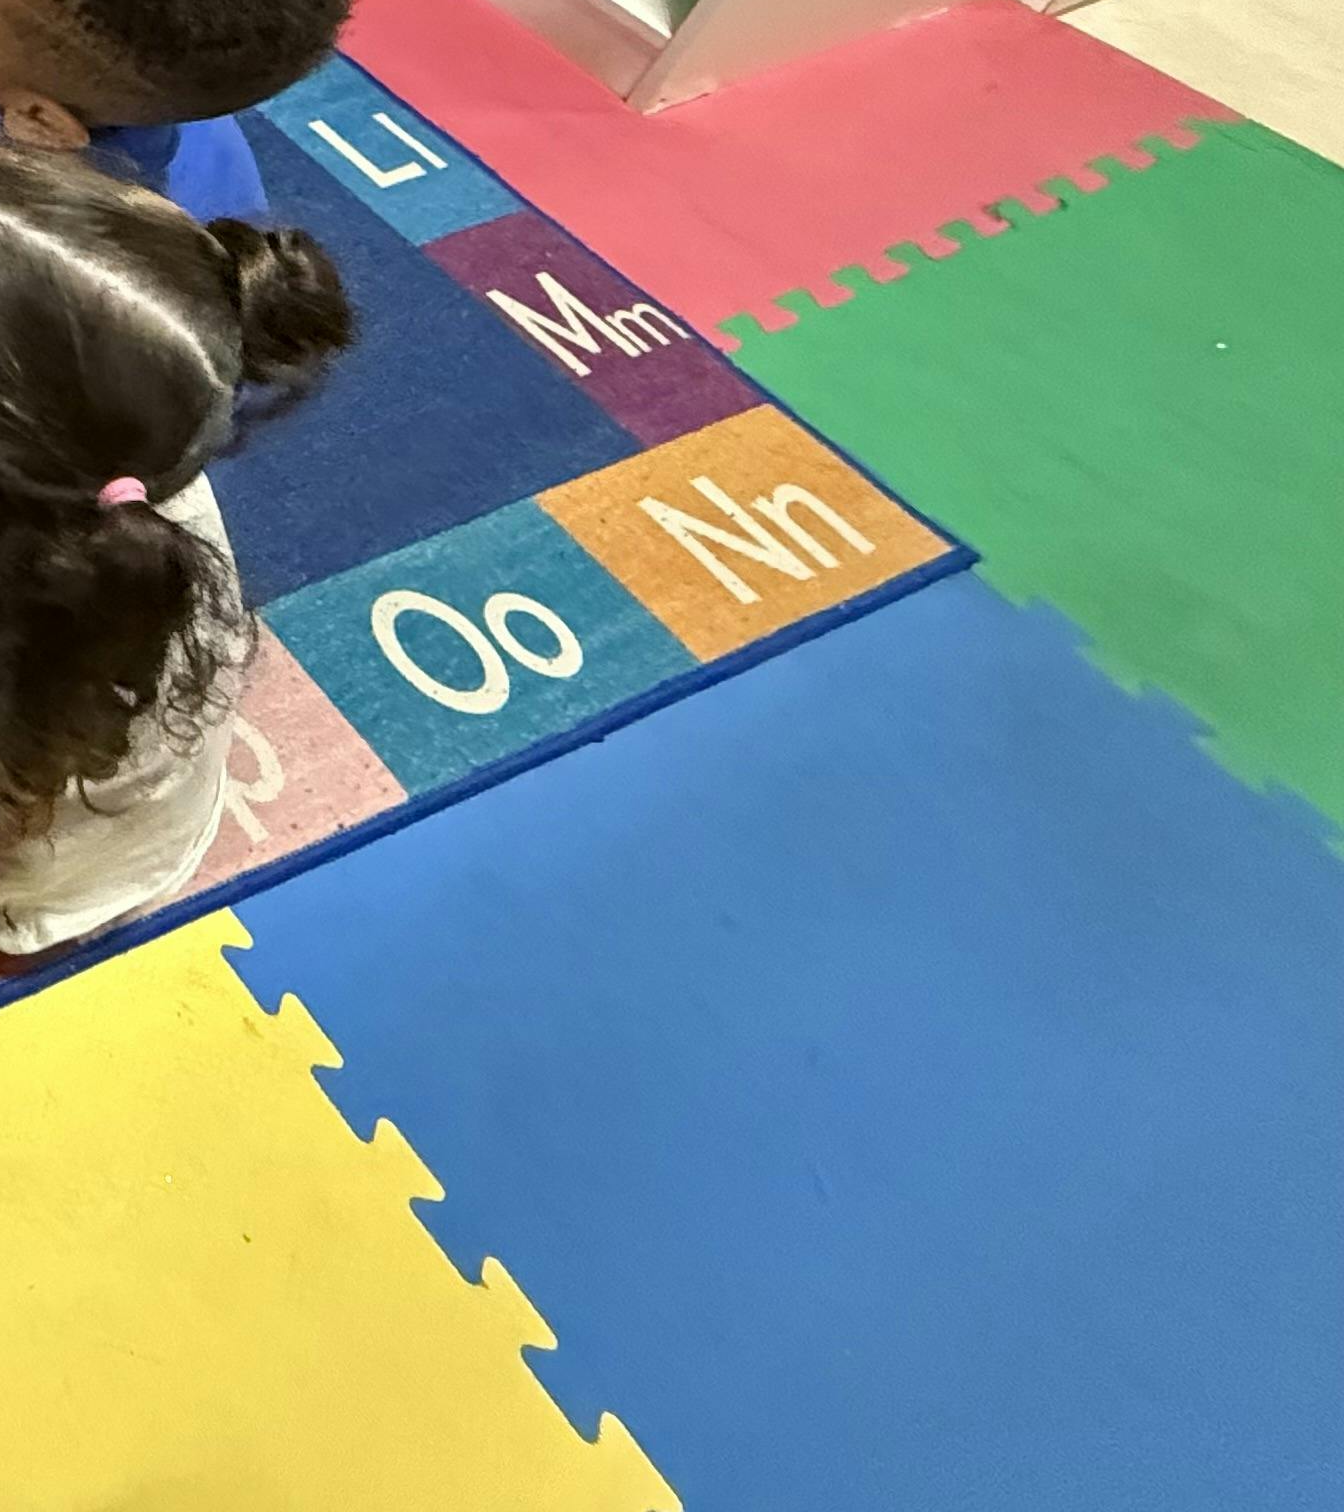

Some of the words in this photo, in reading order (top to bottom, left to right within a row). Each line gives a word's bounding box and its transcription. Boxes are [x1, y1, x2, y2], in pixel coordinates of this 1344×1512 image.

[486, 271, 692, 377] Mm
[637, 475, 876, 604] Nn
[370, 589, 584, 715] Oo
